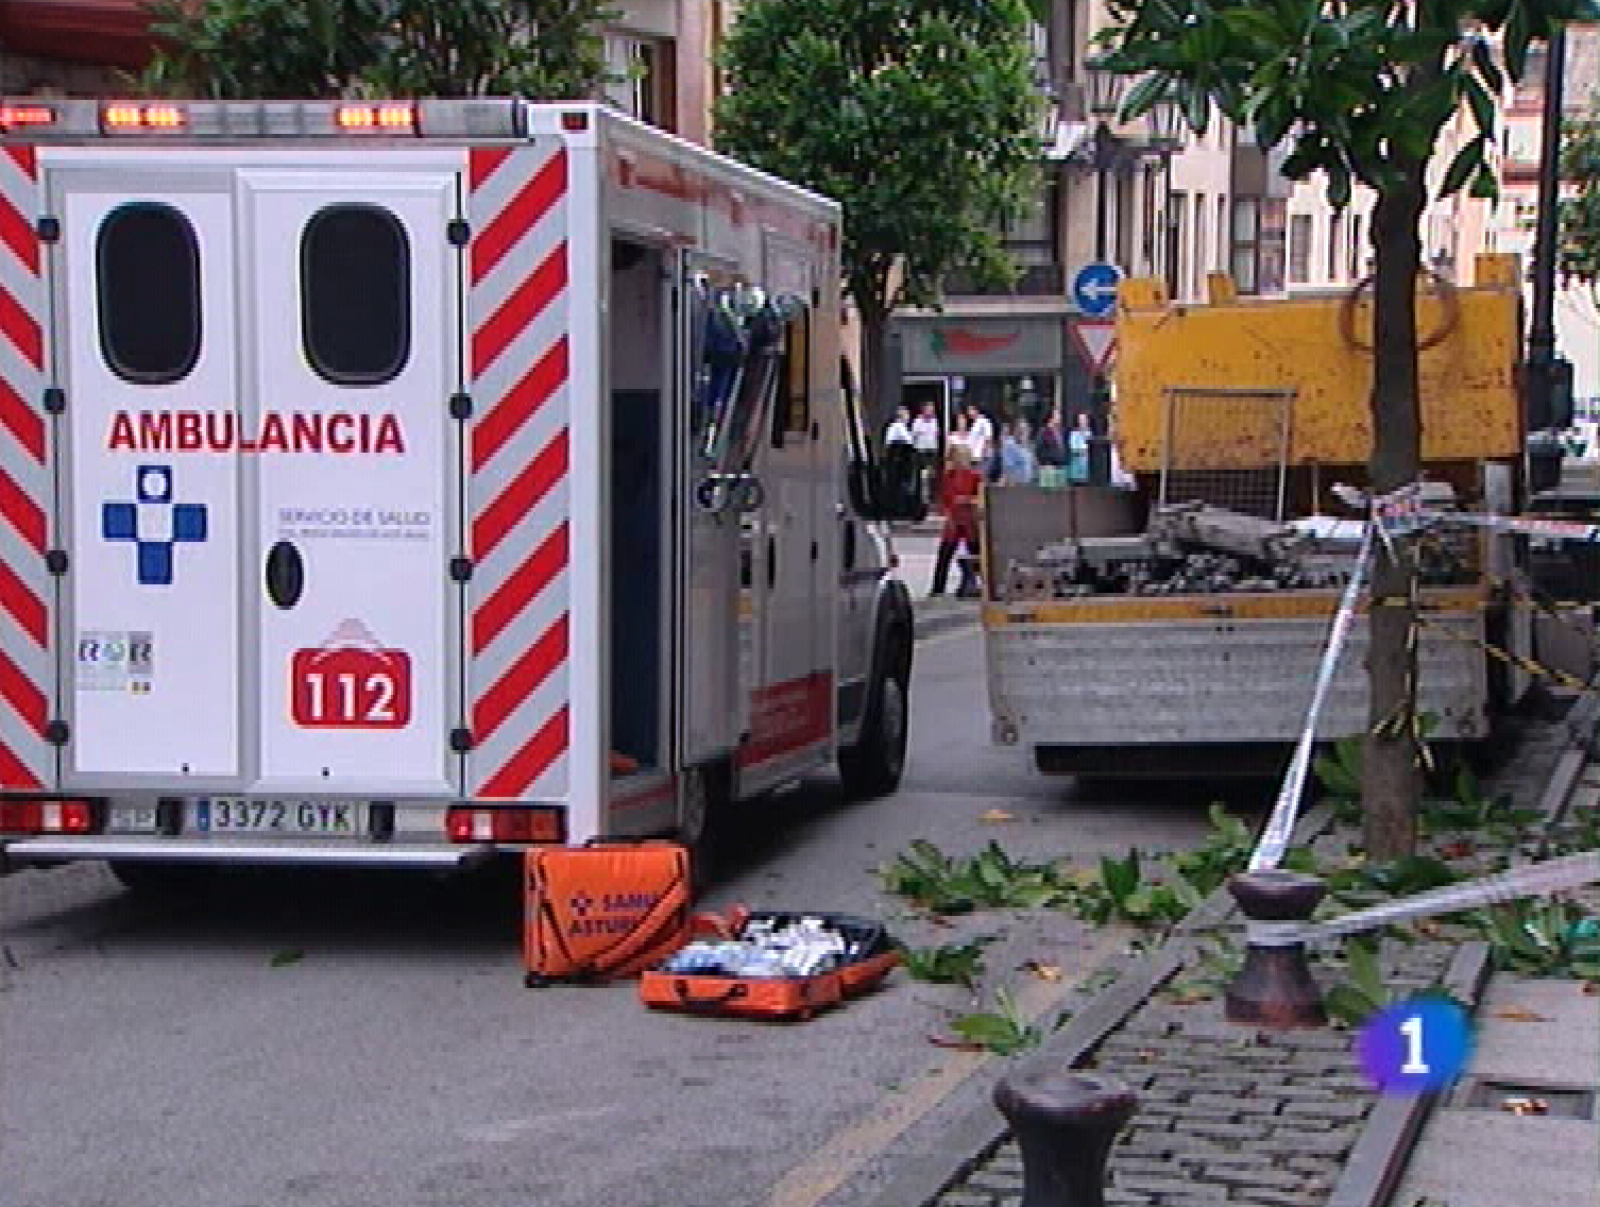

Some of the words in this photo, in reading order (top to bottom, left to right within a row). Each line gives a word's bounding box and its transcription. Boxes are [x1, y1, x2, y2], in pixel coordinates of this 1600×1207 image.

[108, 410, 405, 453] AMBULANCIA
[353, 508, 373, 525] DE
[305, 672, 395, 721] 112
[214, 800, 286, 828] 3372
[297, 800, 352, 829] GYK
